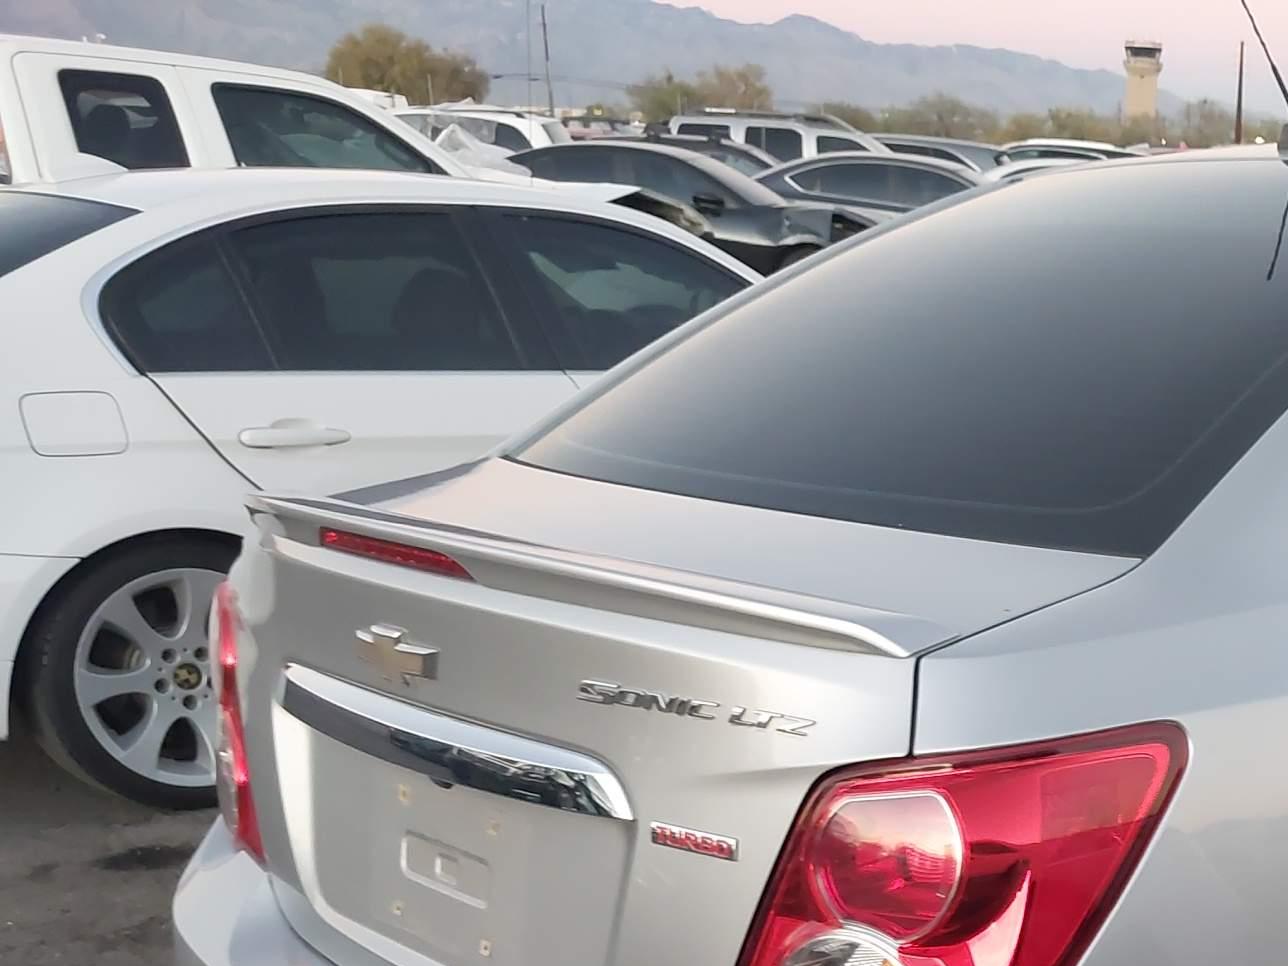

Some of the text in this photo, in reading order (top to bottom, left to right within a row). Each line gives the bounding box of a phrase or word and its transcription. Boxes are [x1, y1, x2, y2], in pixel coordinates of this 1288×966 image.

[576, 679, 817, 737] SONIC LTZ
[652, 824, 735, 859] TURBO
